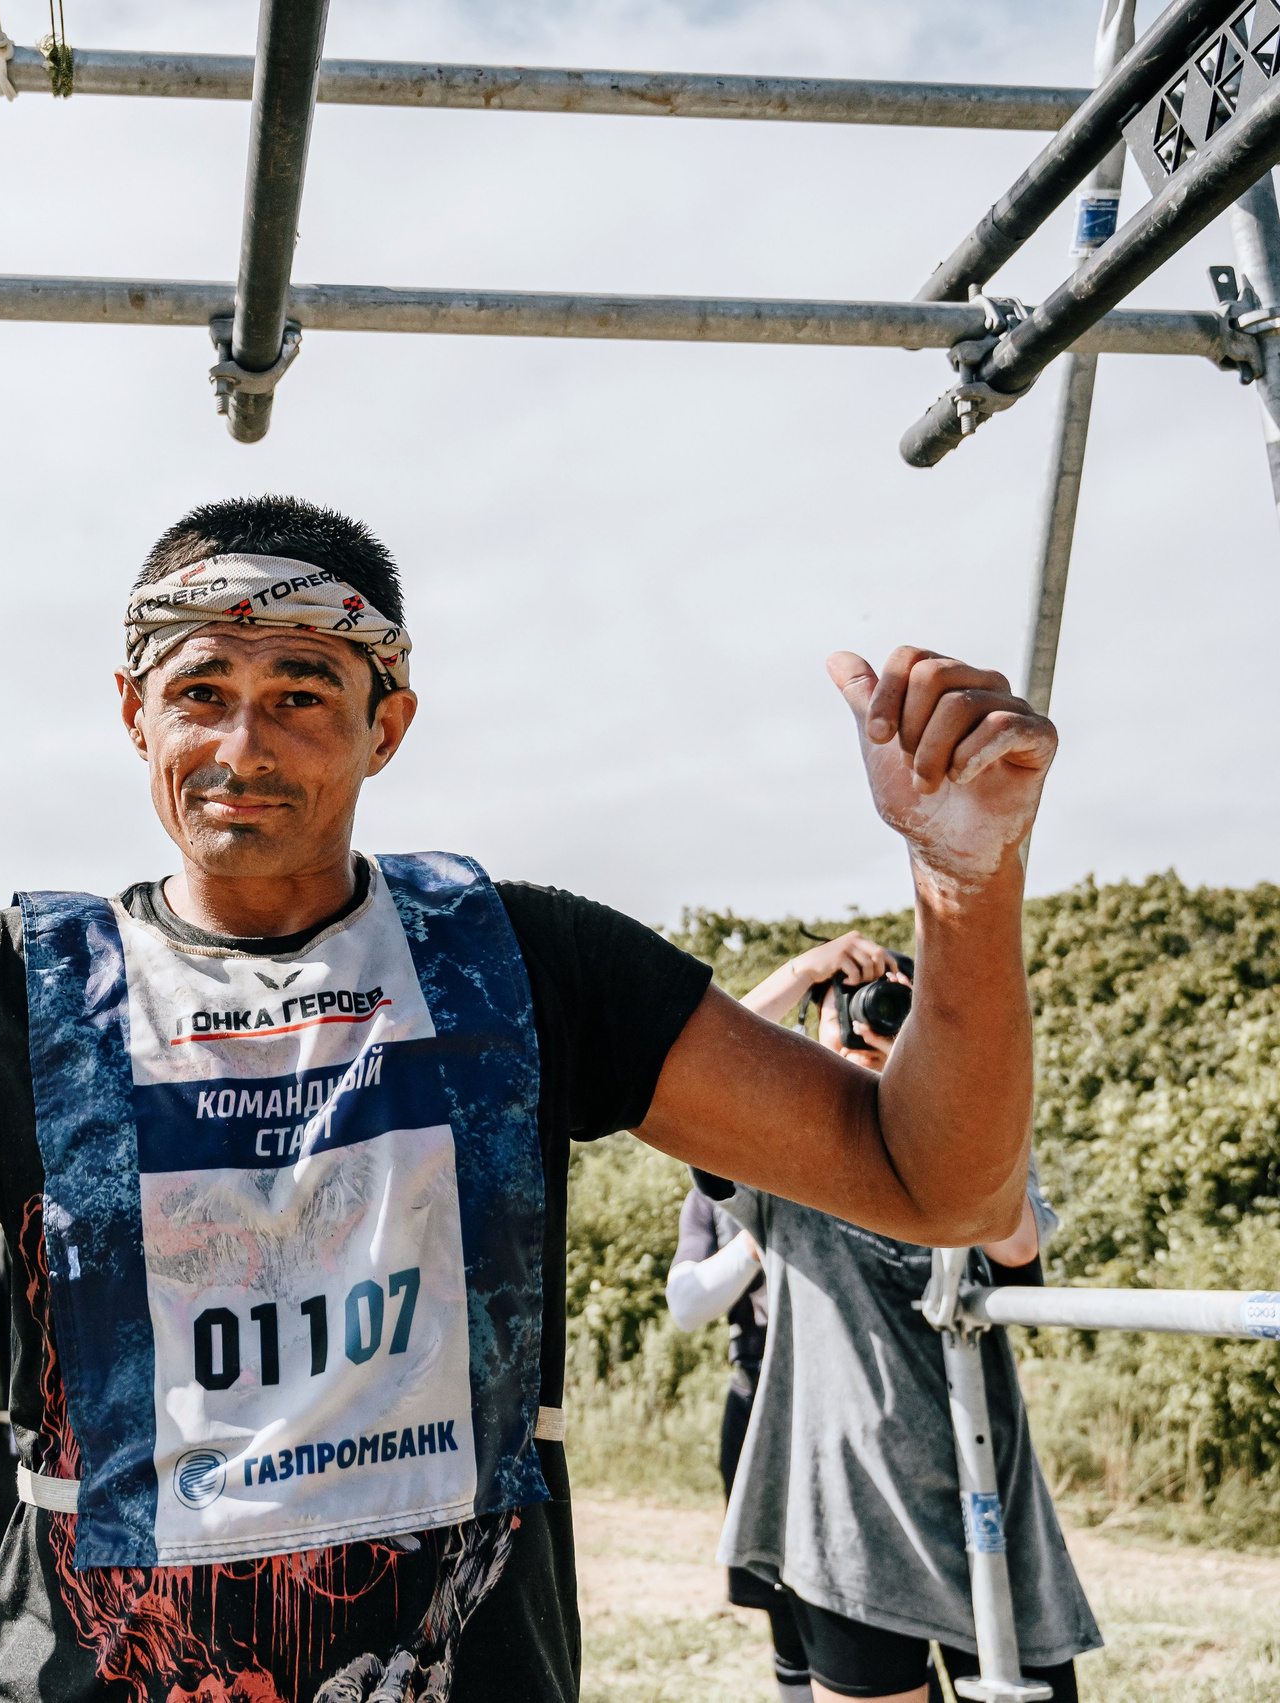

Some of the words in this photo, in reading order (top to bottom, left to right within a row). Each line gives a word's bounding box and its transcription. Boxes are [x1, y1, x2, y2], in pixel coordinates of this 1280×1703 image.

[132, 577, 228, 619] TORERO
[176, 1008, 275, 1036] ГОНКА
[282, 986, 384, 1023] ГЕРОЕВ
[194, 1267, 420, 1391] 01107
[243, 1419, 458, 1487] ГАЗПРОМБАНК
